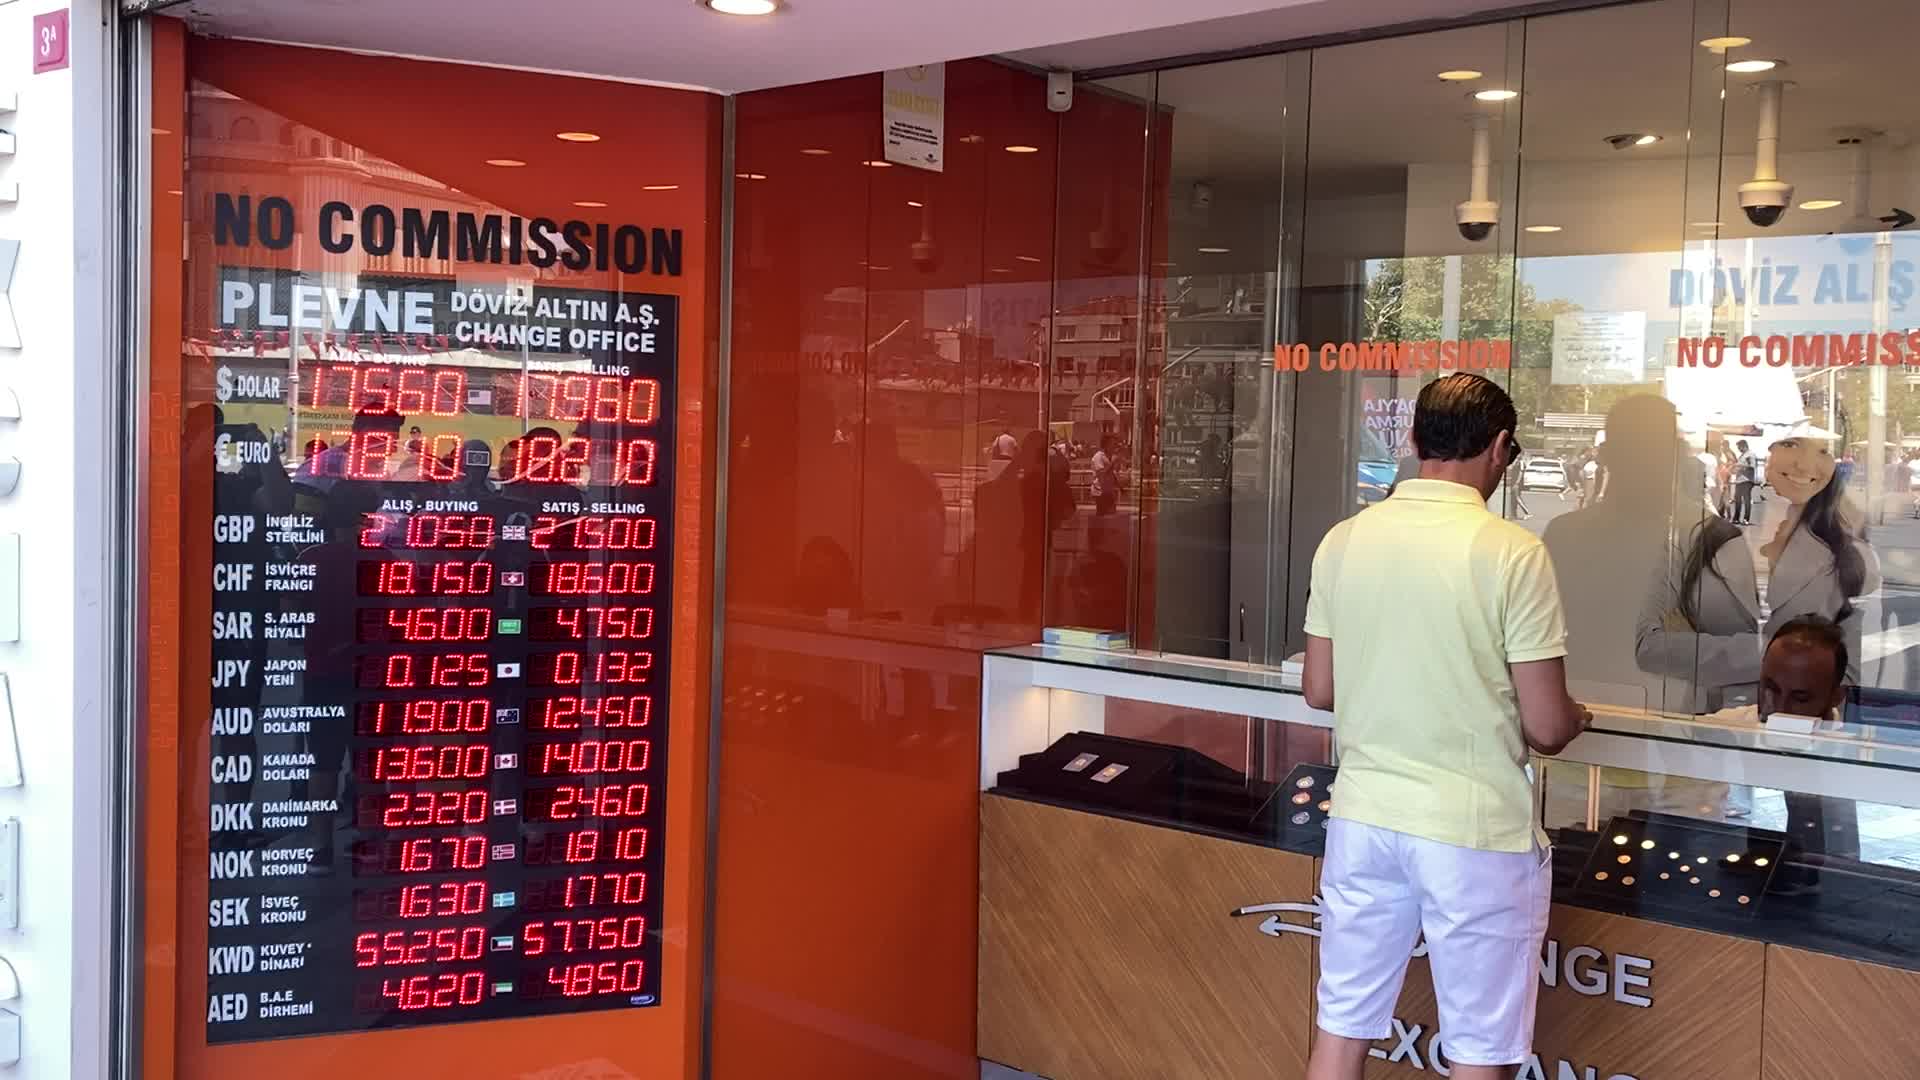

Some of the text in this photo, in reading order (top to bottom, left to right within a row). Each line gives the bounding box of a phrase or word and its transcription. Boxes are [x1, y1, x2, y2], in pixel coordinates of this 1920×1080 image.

[214, 193, 682, 276] NO COMMISSION
[222, 281, 434, 334] PLEVNE
[451, 288, 660, 330] DÖVİZ ALTIN A.Ş.
[455, 321, 655, 353] CHANGE OFFICE
[1274, 339, 1511, 372] NO COMMISSION
[1677, 337, 1725, 368] NO
[238, 375, 280, 399] DOLAR
[236, 441, 271, 464] EURO
[382, 500, 413, 513] ALIŞ
[425, 500, 479, 512] BUYING
[542, 502, 579, 515] SATIŞ
[591, 502, 645, 514] SELLING
[266, 513, 314, 528] İNGİLİZ
[214, 515, 255, 543] GBP
[265, 529, 324, 543] STERLİNİ
[213, 563, 254, 591] CHF
[265, 562, 317, 578] İSVİÇRE
[265, 579, 313, 591] FRANGI
[212, 611, 253, 639] SAR
[264, 612, 315, 624] S. ARAB
[264, 625, 306, 638] RİYALİ
[264, 660, 307, 671] JAPON
[212, 660, 251, 687] JPY
[264, 673, 294, 686] YENİ
[263, 706, 345, 718] AVUSTRALYA
[211, 708, 252, 735] AUD
[263, 721, 310, 733] DOLARI
[263, 754, 315, 766] KANADA
[211, 755, 251, 783] CAD
[263, 768, 309, 781] DOLARI
[262, 800, 338, 813] DANİMARKA
[210, 803, 254, 831] DKK
[262, 816, 307, 829] KRONU
[262, 848, 313, 862] NORVEÇ
[210, 850, 254, 879] NOK
[262, 863, 307, 876] KRONU
[261, 896, 299, 910] İSVEÇ
[209, 898, 250, 927] SEK
[261, 911, 306, 924] KRONU
[209, 946, 254, 975] KWD
[260, 956, 304, 971] DİNARI
[260, 991, 293, 1003] B.A.E
[207, 994, 248, 1023] AED
[260, 1001, 313, 1018] DİRHEMİ
